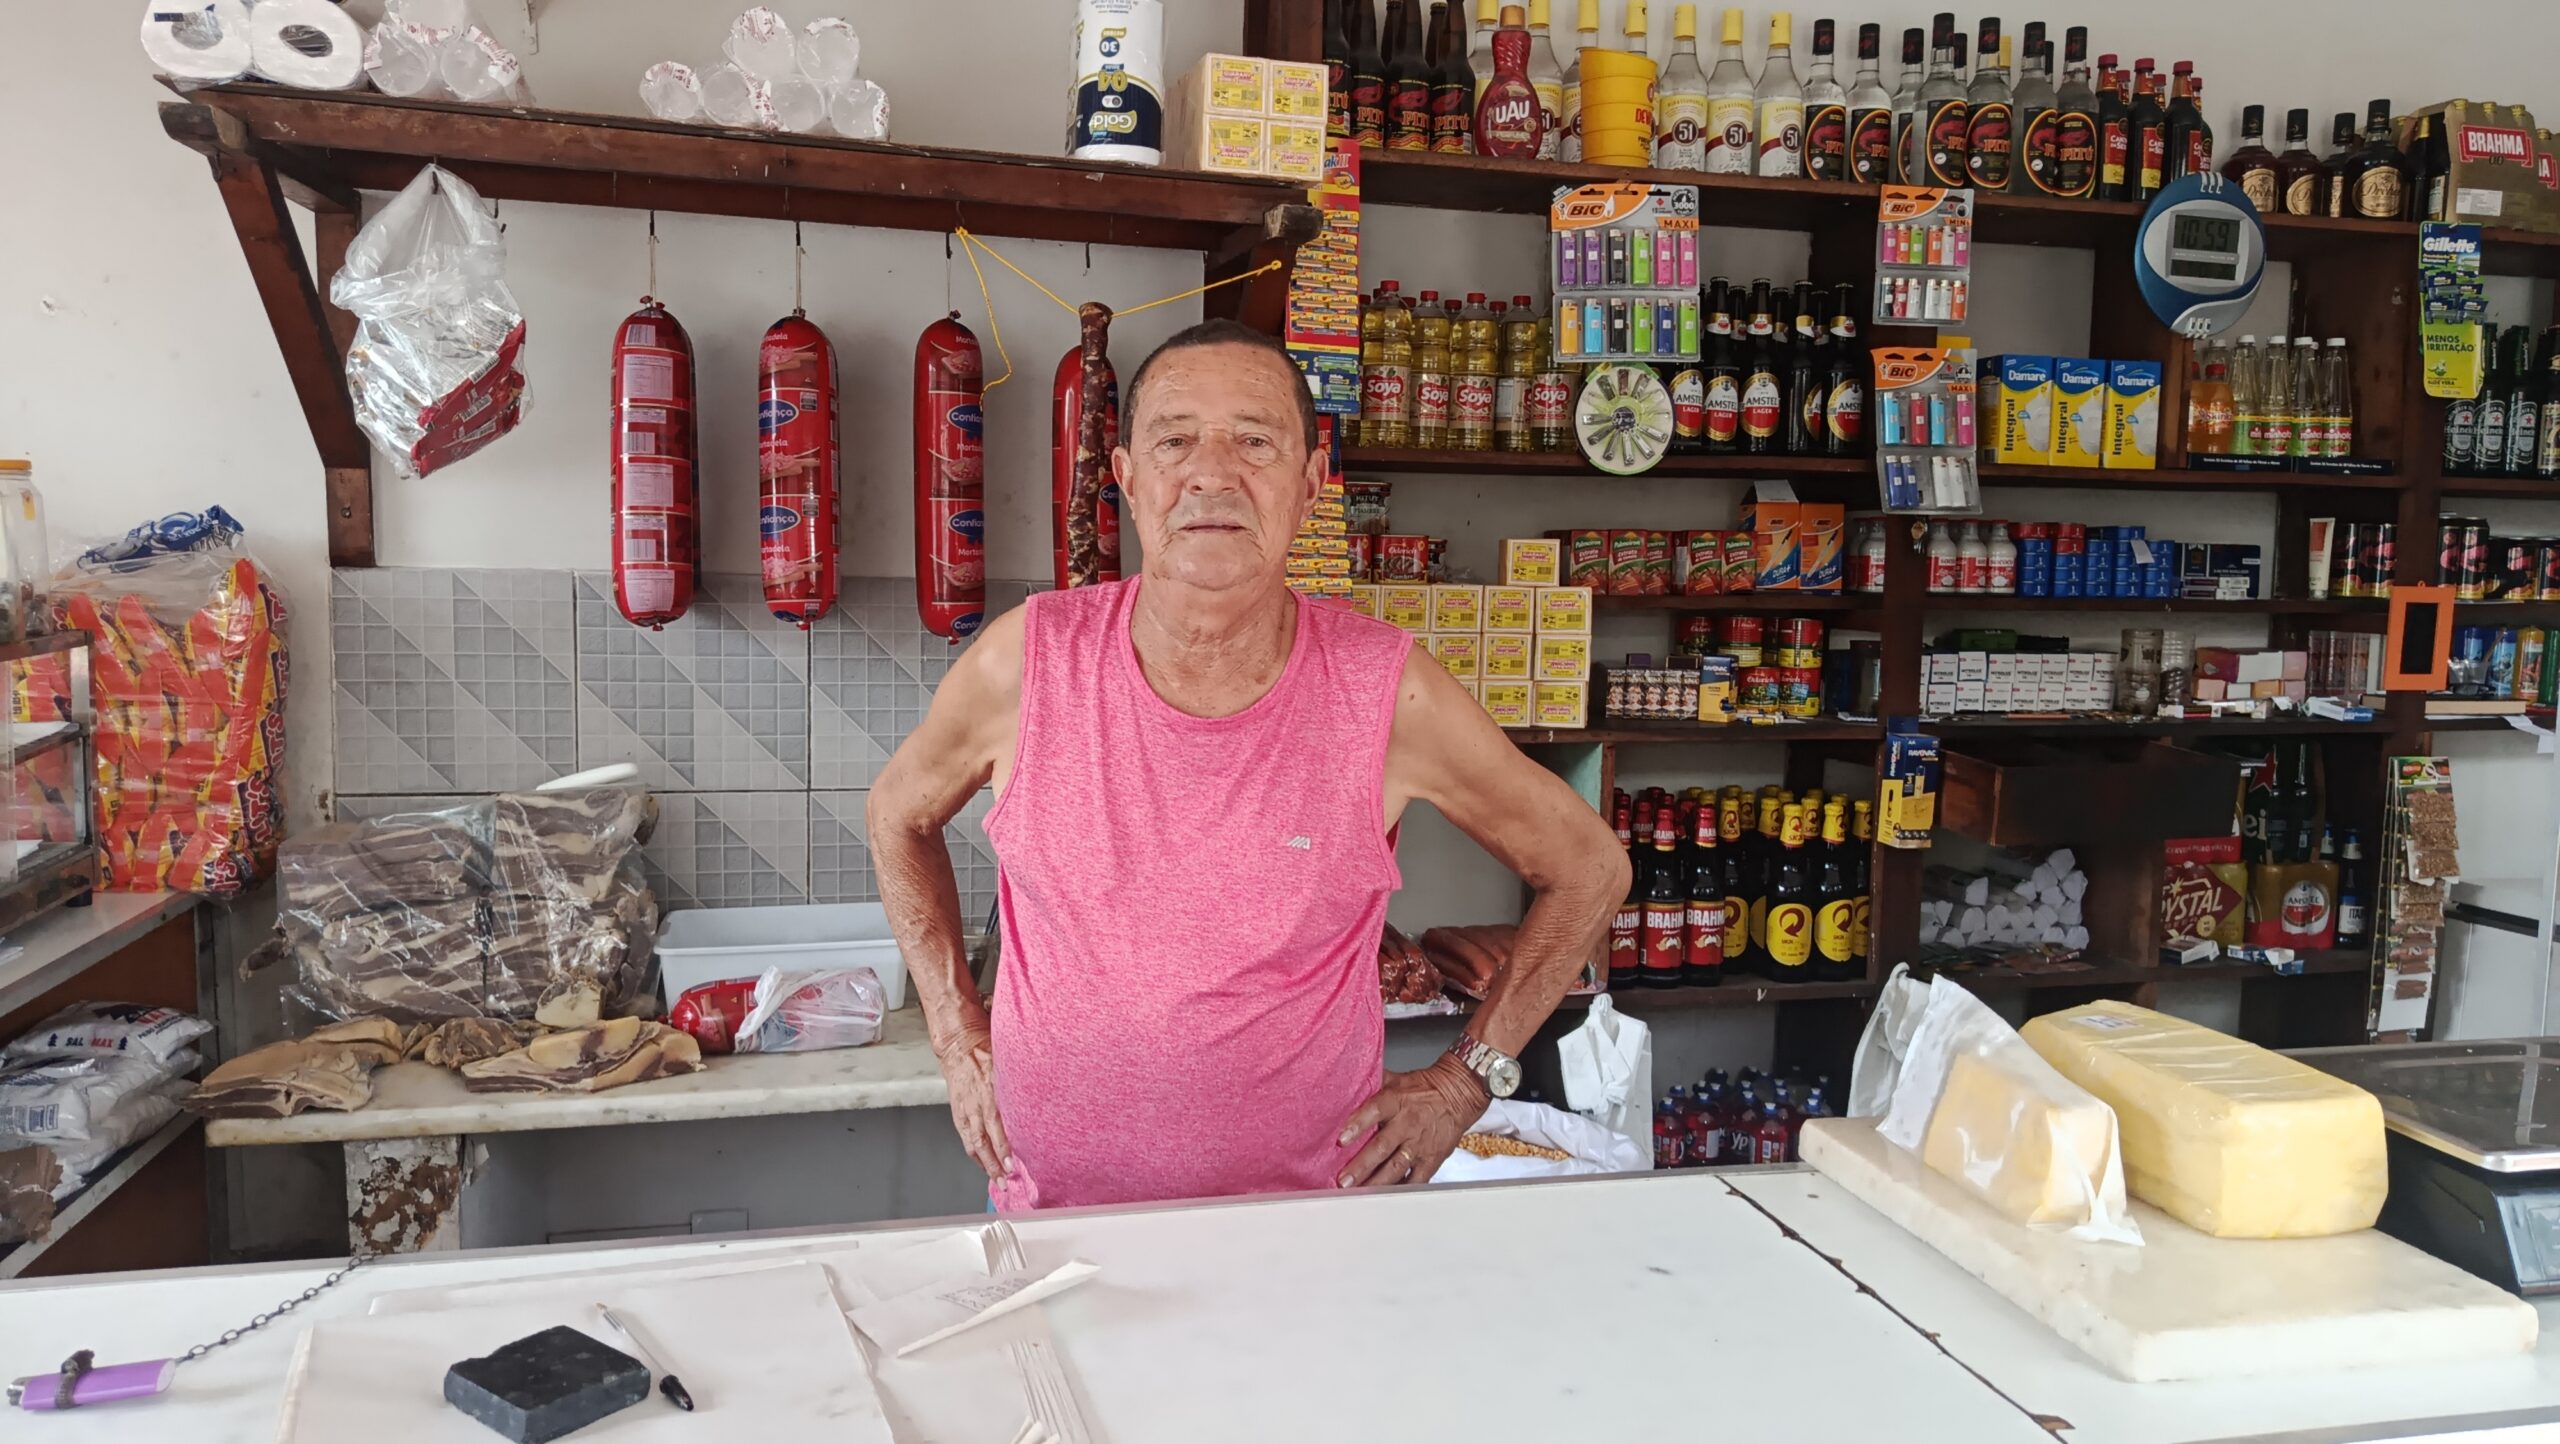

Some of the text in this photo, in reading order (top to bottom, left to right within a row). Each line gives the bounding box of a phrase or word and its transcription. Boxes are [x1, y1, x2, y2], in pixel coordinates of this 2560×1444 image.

[1101, 41, 1118, 53] 30
[1097, 70, 1128, 92] 04
[1495, 100, 1530, 123] UAU
[1434, 112, 1470, 131] PITÚ
[1678, 123, 1693, 140] 51
[1729, 126, 1744, 144] 51
[1786, 129, 1799, 147] 51
[2466, 131, 2526, 156] BRAHMA
[1569, 205, 1603, 217] BIC
[1673, 201, 1695, 210] 3000
[1891, 204, 1915, 214] BIC
[1663, 219, 1694, 229] MAXI
[2422, 236, 2477, 254] Gillette
[2426, 334, 2461, 344] MENOS
[1889, 367, 1915, 378] BIC
[2009, 369, 2046, 382] Damare
[2062, 372, 2099, 385] Damare
[1366, 379, 1402, 396] Soya
[2117, 375, 2155, 387] Damare
[1534, 387, 1568, 404] Soya
[1950, 385, 1974, 393] MAXI
[1459, 389, 1492, 407] Soya
[1746, 396, 1778, 407] AMSTEL
[1752, 407, 1773, 415] LAGER
[2004, 399, 2016, 452] Integral
[2056, 401, 2068, 454] Integral
[2111, 403, 2124, 456] Integral
[1907, 749, 1937, 757] RAYOVAC
[65, 1037, 114, 1049] SAL MAX
